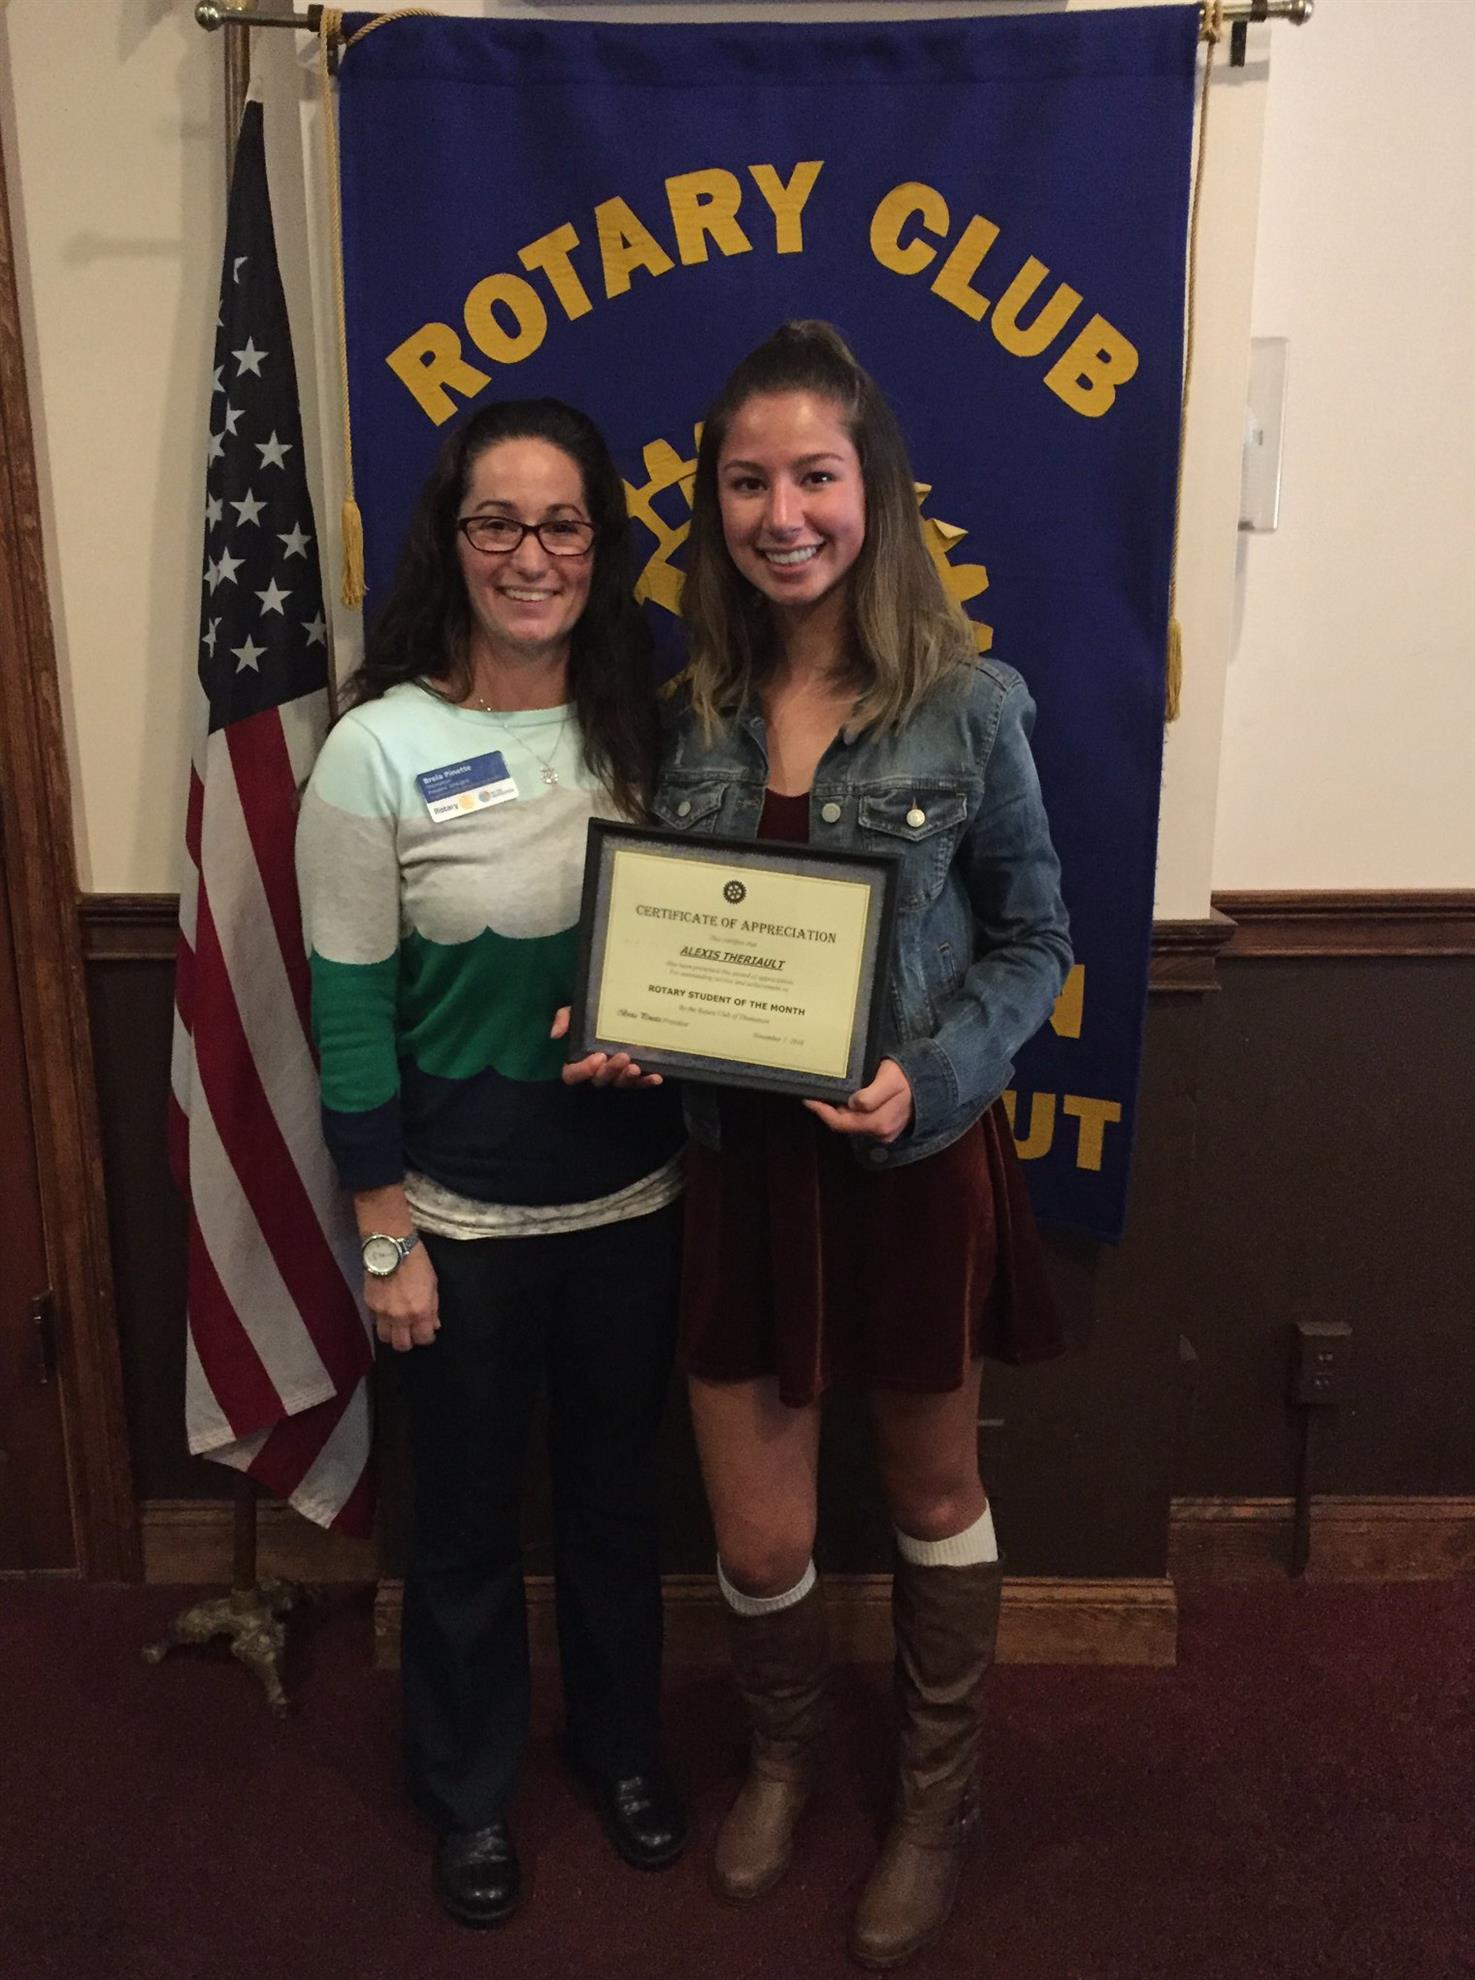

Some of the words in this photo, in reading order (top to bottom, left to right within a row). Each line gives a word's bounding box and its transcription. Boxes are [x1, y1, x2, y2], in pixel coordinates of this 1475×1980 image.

[385, 161, 824, 428] ROTARY
[870, 182, 1140, 418] CLUB
[635, 904, 718, 927] CERTIFICATE
[720, 917, 738, 929] OF
[740, 920, 837, 944] APPRECIATION
[680, 946, 721, 961] ALEXIS
[722, 951, 786, 971] THERIAULT
[648, 984, 686, 998] ROTARY
[688, 990, 732, 1005] STUDENT
[733, 998, 746, 1007] OF
[750, 1000, 768, 1010] THE
[770, 1003, 806, 1016] MONTH
[1002, 1089, 1122, 1171] UT
